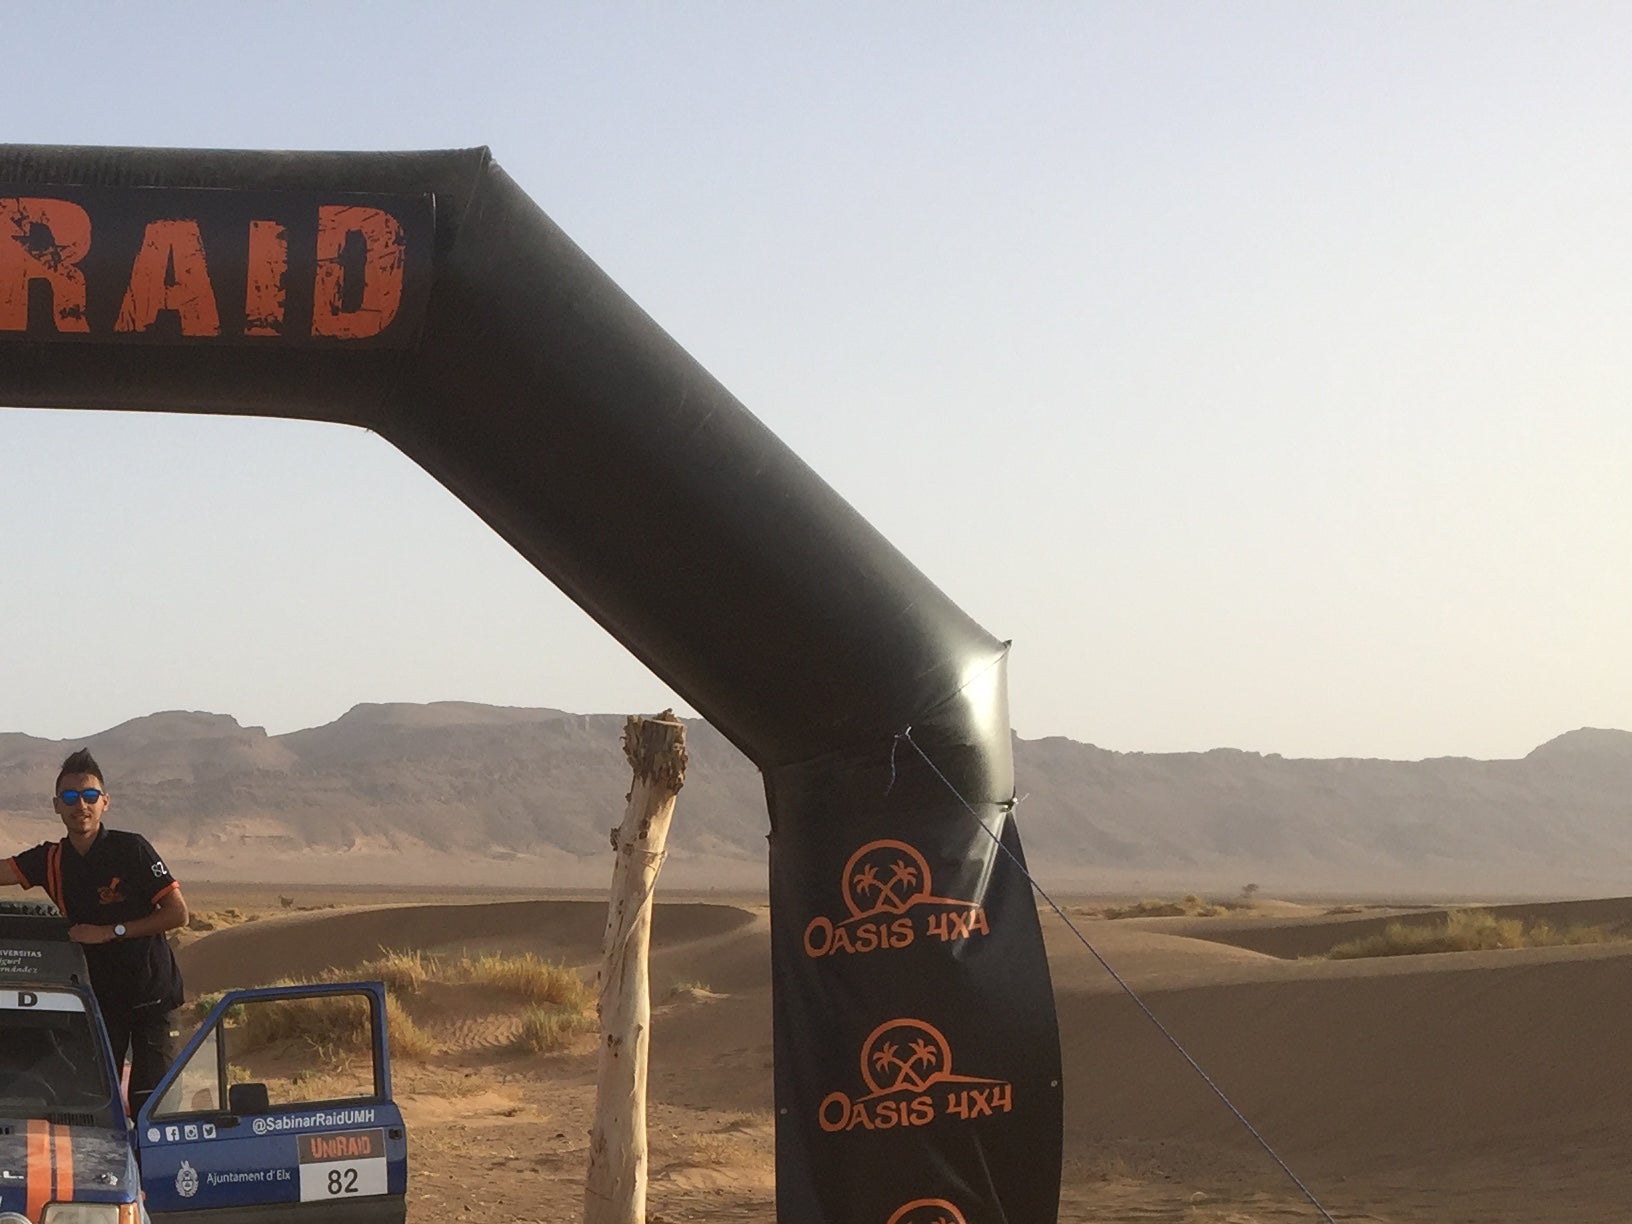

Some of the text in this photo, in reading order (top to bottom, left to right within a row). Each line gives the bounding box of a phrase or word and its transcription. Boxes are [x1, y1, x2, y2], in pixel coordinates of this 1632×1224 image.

[151, 861, 168, 878] 82
[804, 916, 914, 958] OASIS
[252, 1110, 375, 1135] @SabinarRaidUMH
[819, 1091, 935, 1132] OASIS
[206, 1170, 264, 1186] Ajuntament
[328, 1168, 359, 1194] 82
